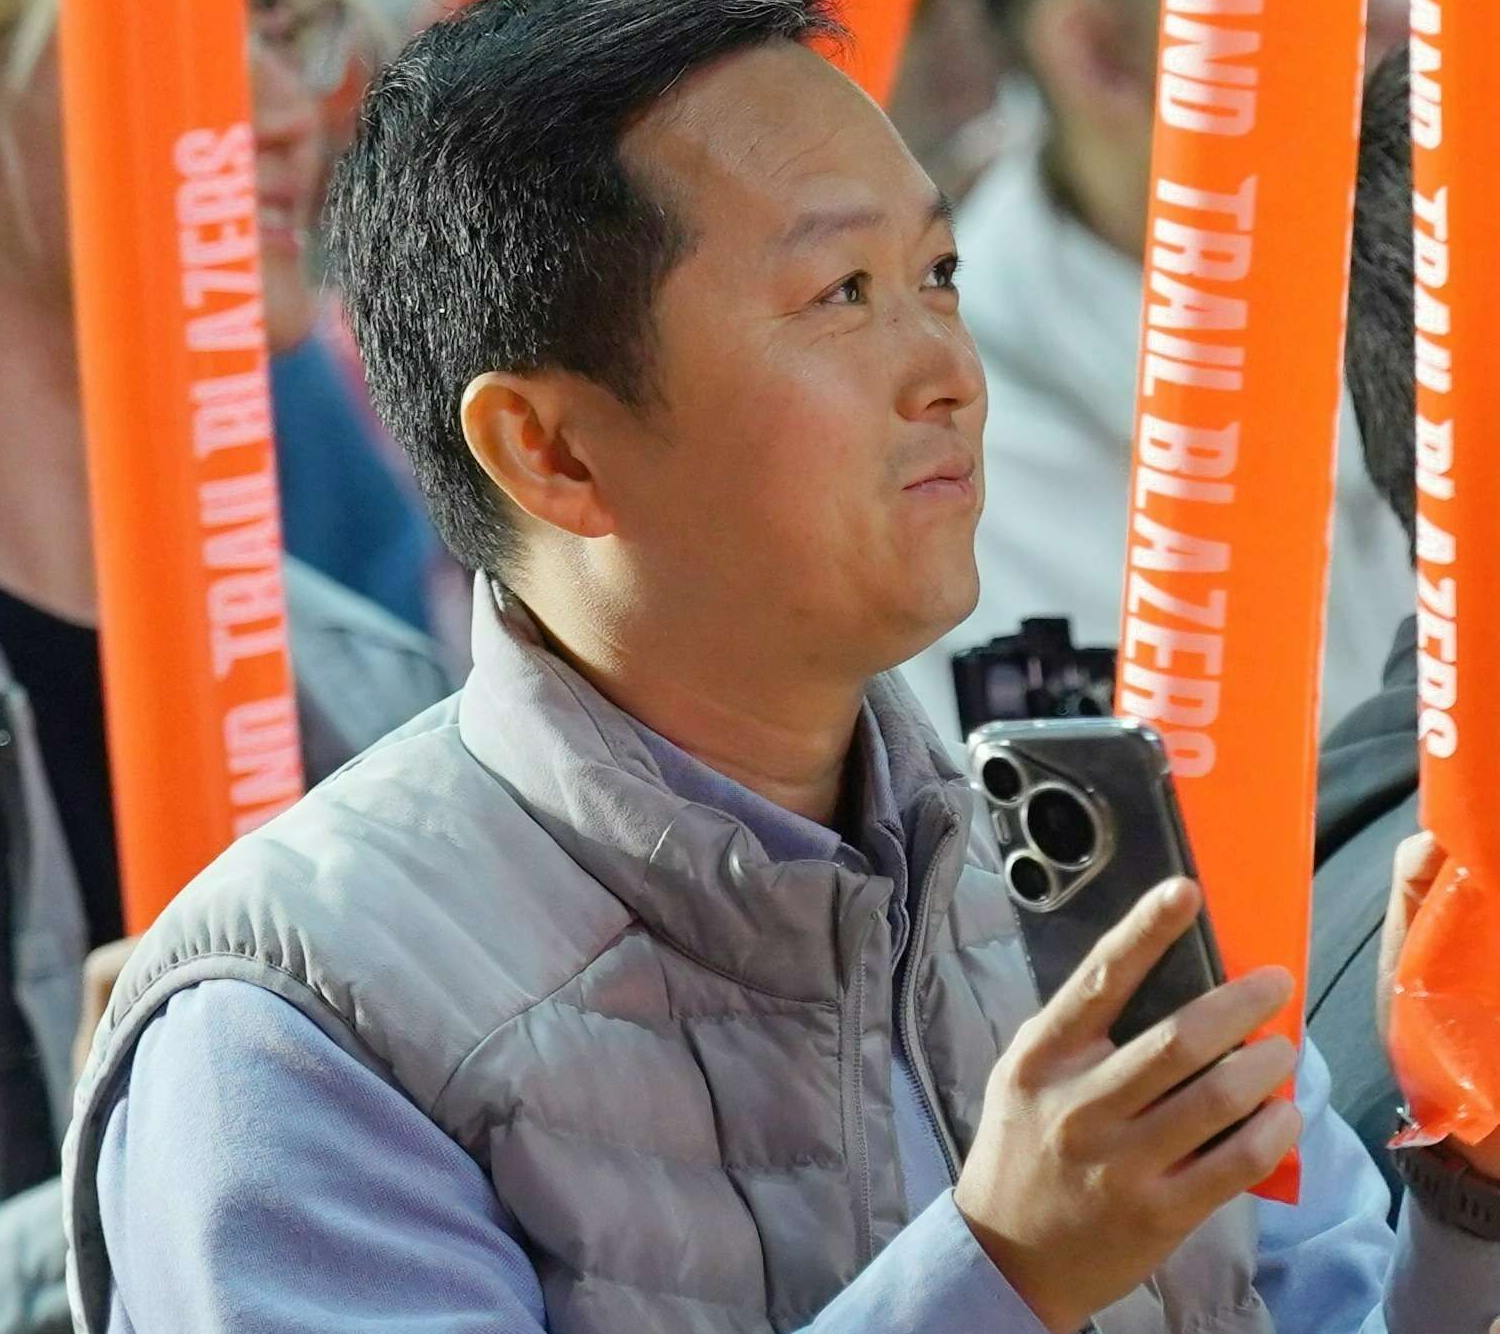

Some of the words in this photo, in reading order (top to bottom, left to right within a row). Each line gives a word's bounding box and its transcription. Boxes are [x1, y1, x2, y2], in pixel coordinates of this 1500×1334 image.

[172, 120, 270, 460] BLAZERS
[1143, 174, 1259, 396] TRAIL
[194, 451, 283, 678] TRAIL
